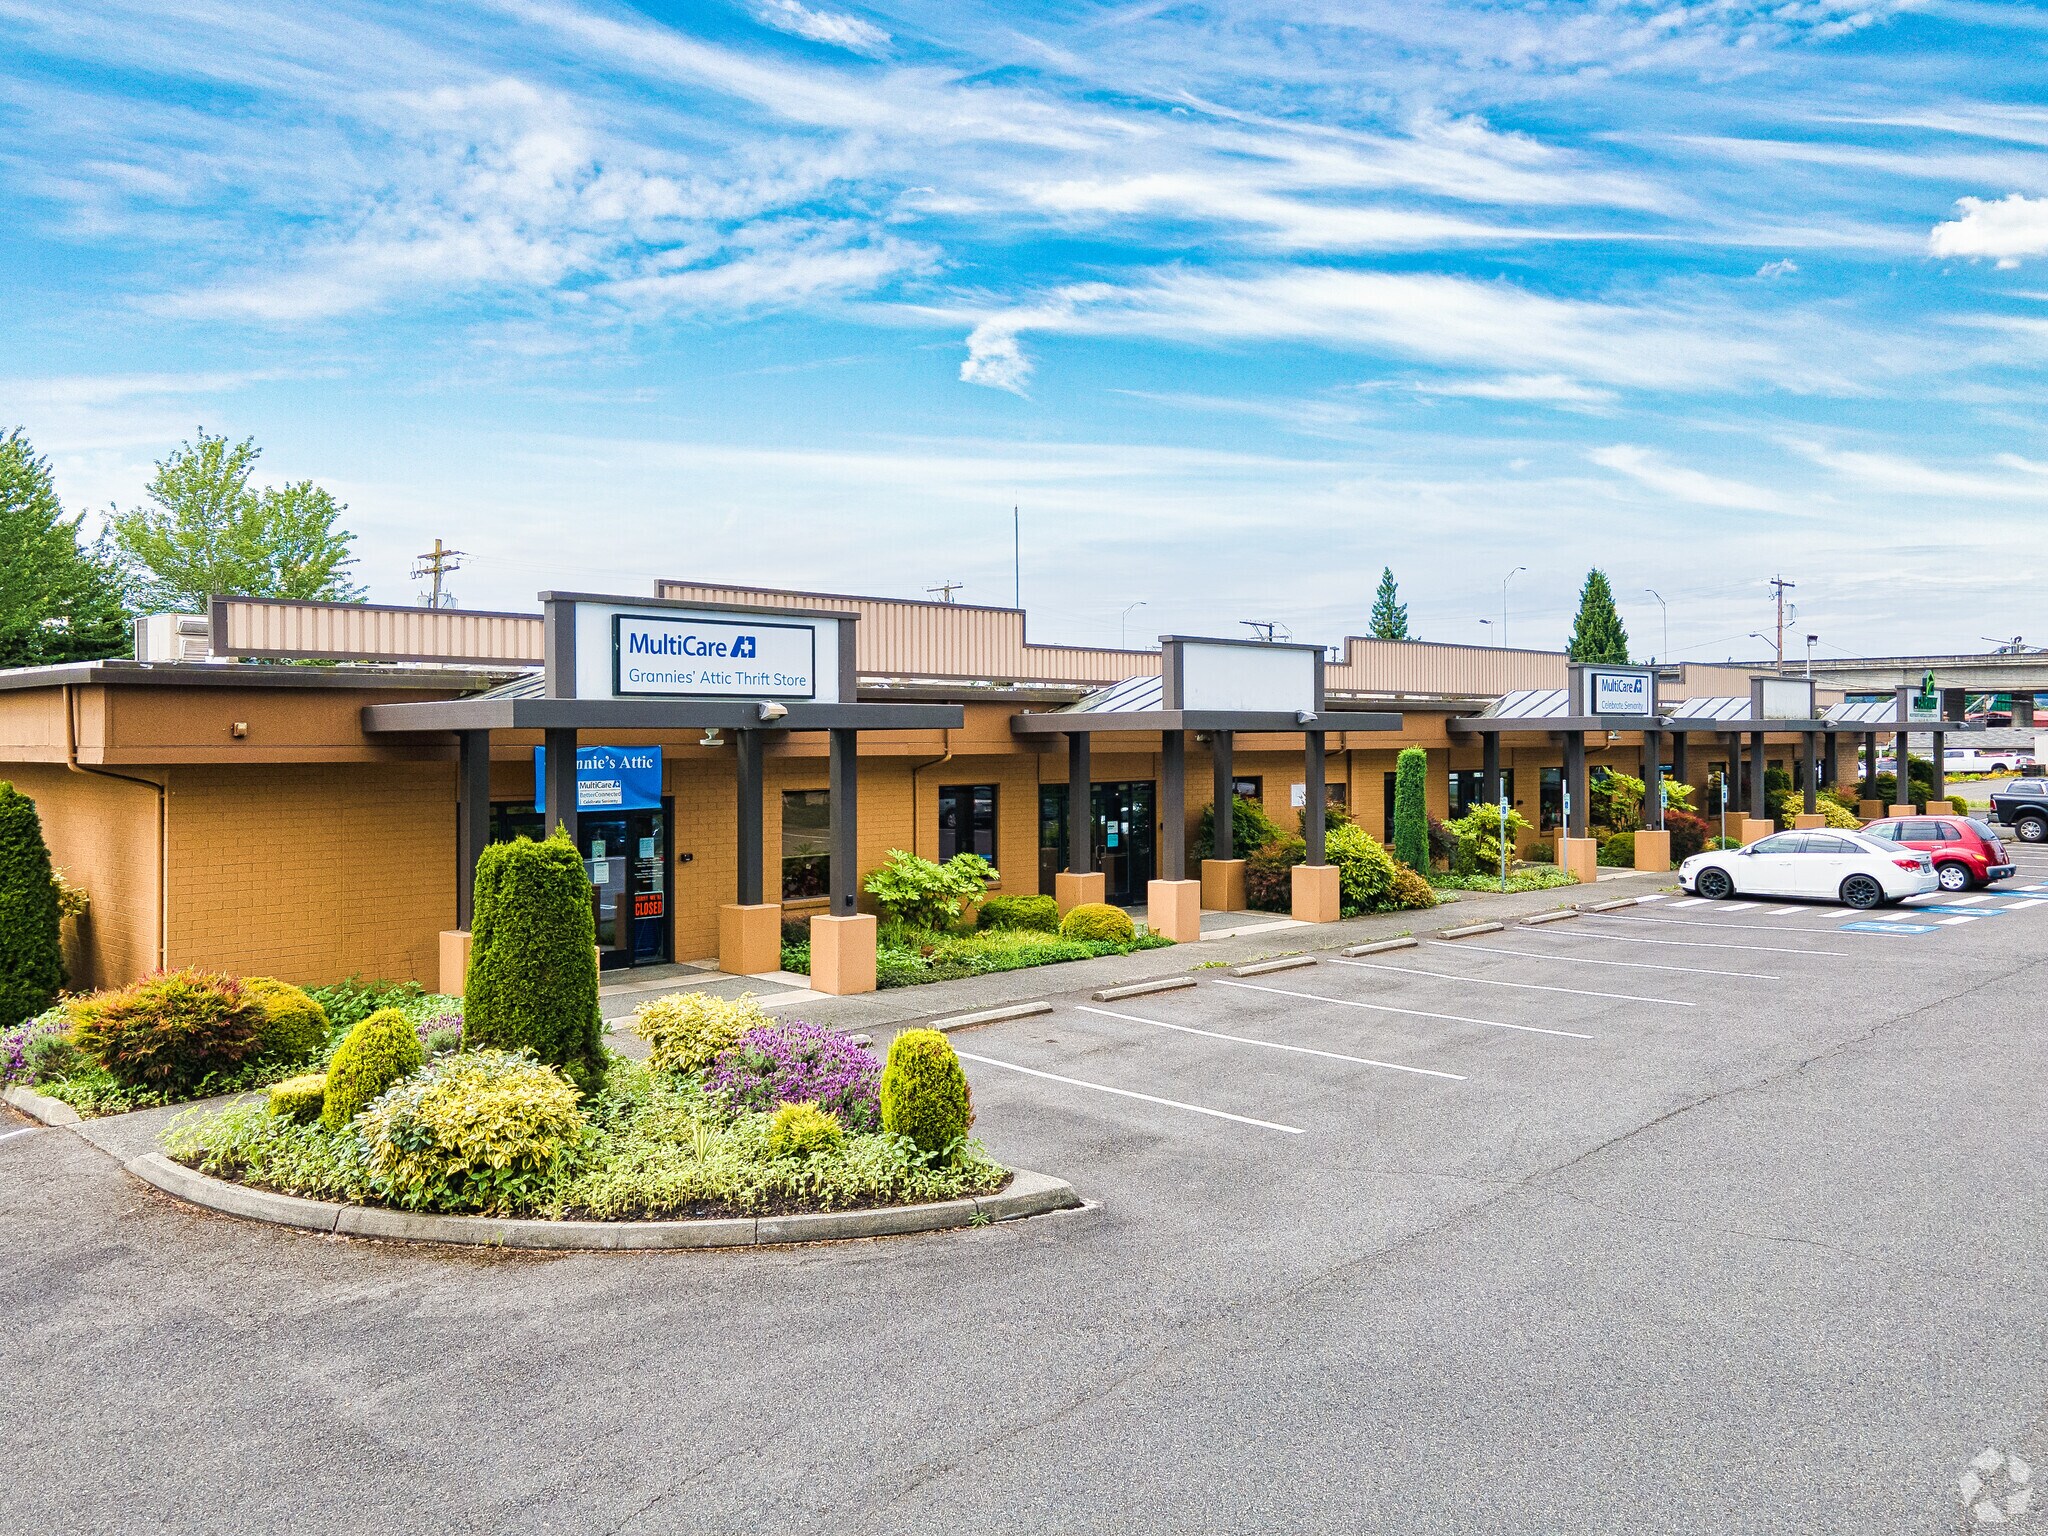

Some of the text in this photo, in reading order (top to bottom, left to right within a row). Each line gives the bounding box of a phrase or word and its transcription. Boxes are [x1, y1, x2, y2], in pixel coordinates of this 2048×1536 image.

[629, 632, 727, 658] MultiCare
[629, 668, 807, 687] Grannies' Attic Thrift Store
[1602, 679, 1633, 692] MultiCare
[1602, 701, 1623, 709] Celebrate
[619, 755, 654, 769] Attic
[579, 781, 612, 789] MultiCare
[635, 901, 663, 917] CLOSED
